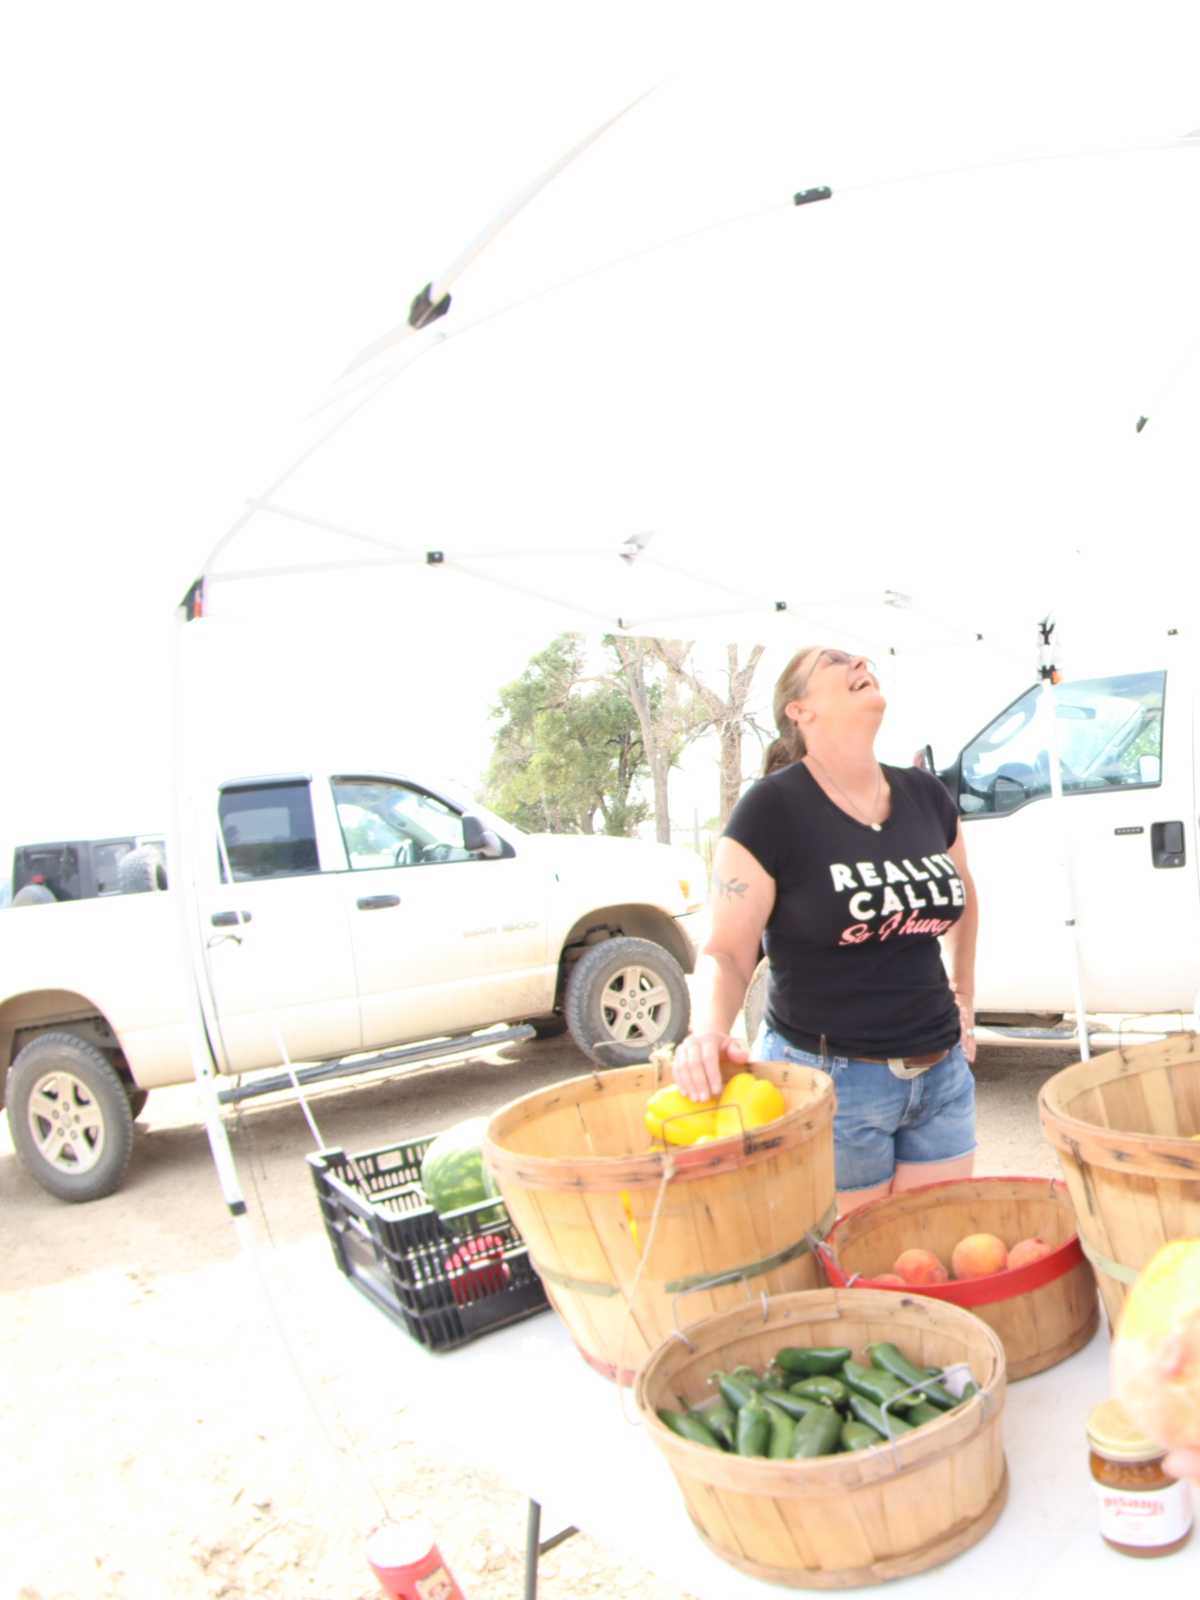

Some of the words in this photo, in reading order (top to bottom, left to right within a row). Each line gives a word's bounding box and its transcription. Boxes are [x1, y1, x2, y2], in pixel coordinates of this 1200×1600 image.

[849, 879, 966, 921] CALLE
[838, 923, 875, 945] So
[898, 908, 953, 937] hung
